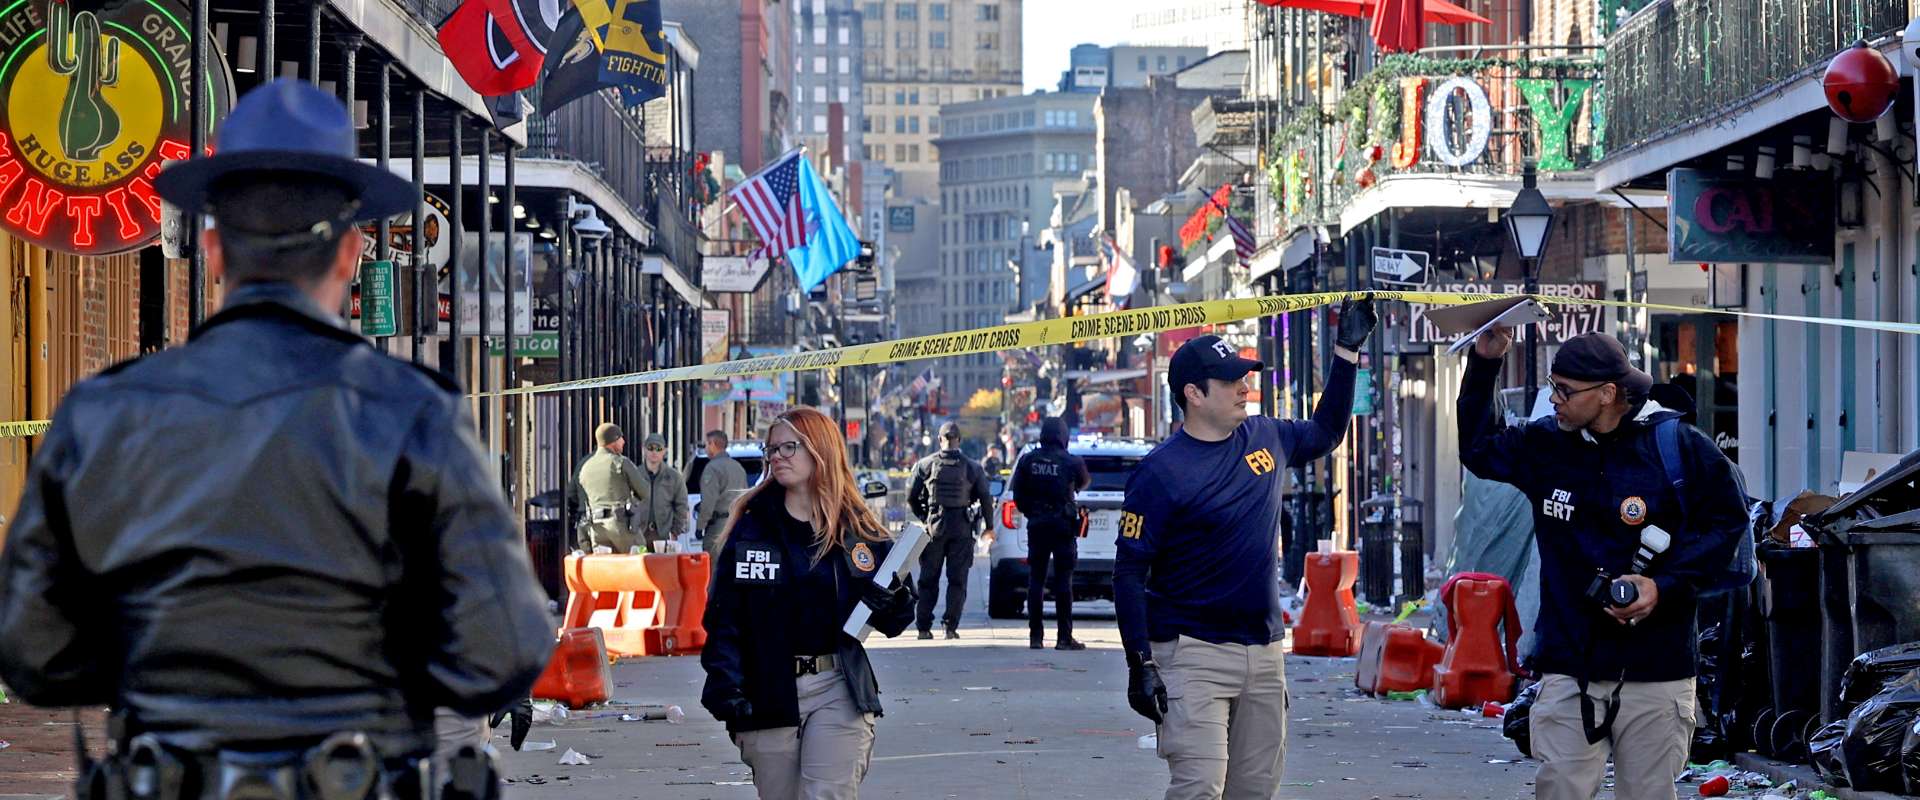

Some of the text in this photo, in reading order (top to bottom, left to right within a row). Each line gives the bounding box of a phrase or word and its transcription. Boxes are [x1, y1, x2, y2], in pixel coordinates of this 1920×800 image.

[1391, 76, 1593, 170] JOY
[19, 133, 145, 183] HUGE ASS
[1257, 297, 1291, 314] CRIME
[1071, 306, 1207, 338] CRIME SCENE DO NOT CROSS
[1556, 303, 1602, 344] JAZZ
[889, 328, 1020, 359] CRIME SCENE DO NOT CROSS
[774, 356, 789, 369] DO
[790, 354, 812, 368] NOT
[813, 350, 843, 366] CROSS
[1031, 463, 1059, 476] SWAT
[1245, 447, 1275, 476] FBI
[1552, 488, 1572, 503] FBI
[1543, 499, 1575, 521] ERT
[746, 550, 771, 562] FBI
[735, 562, 780, 580] ERT
